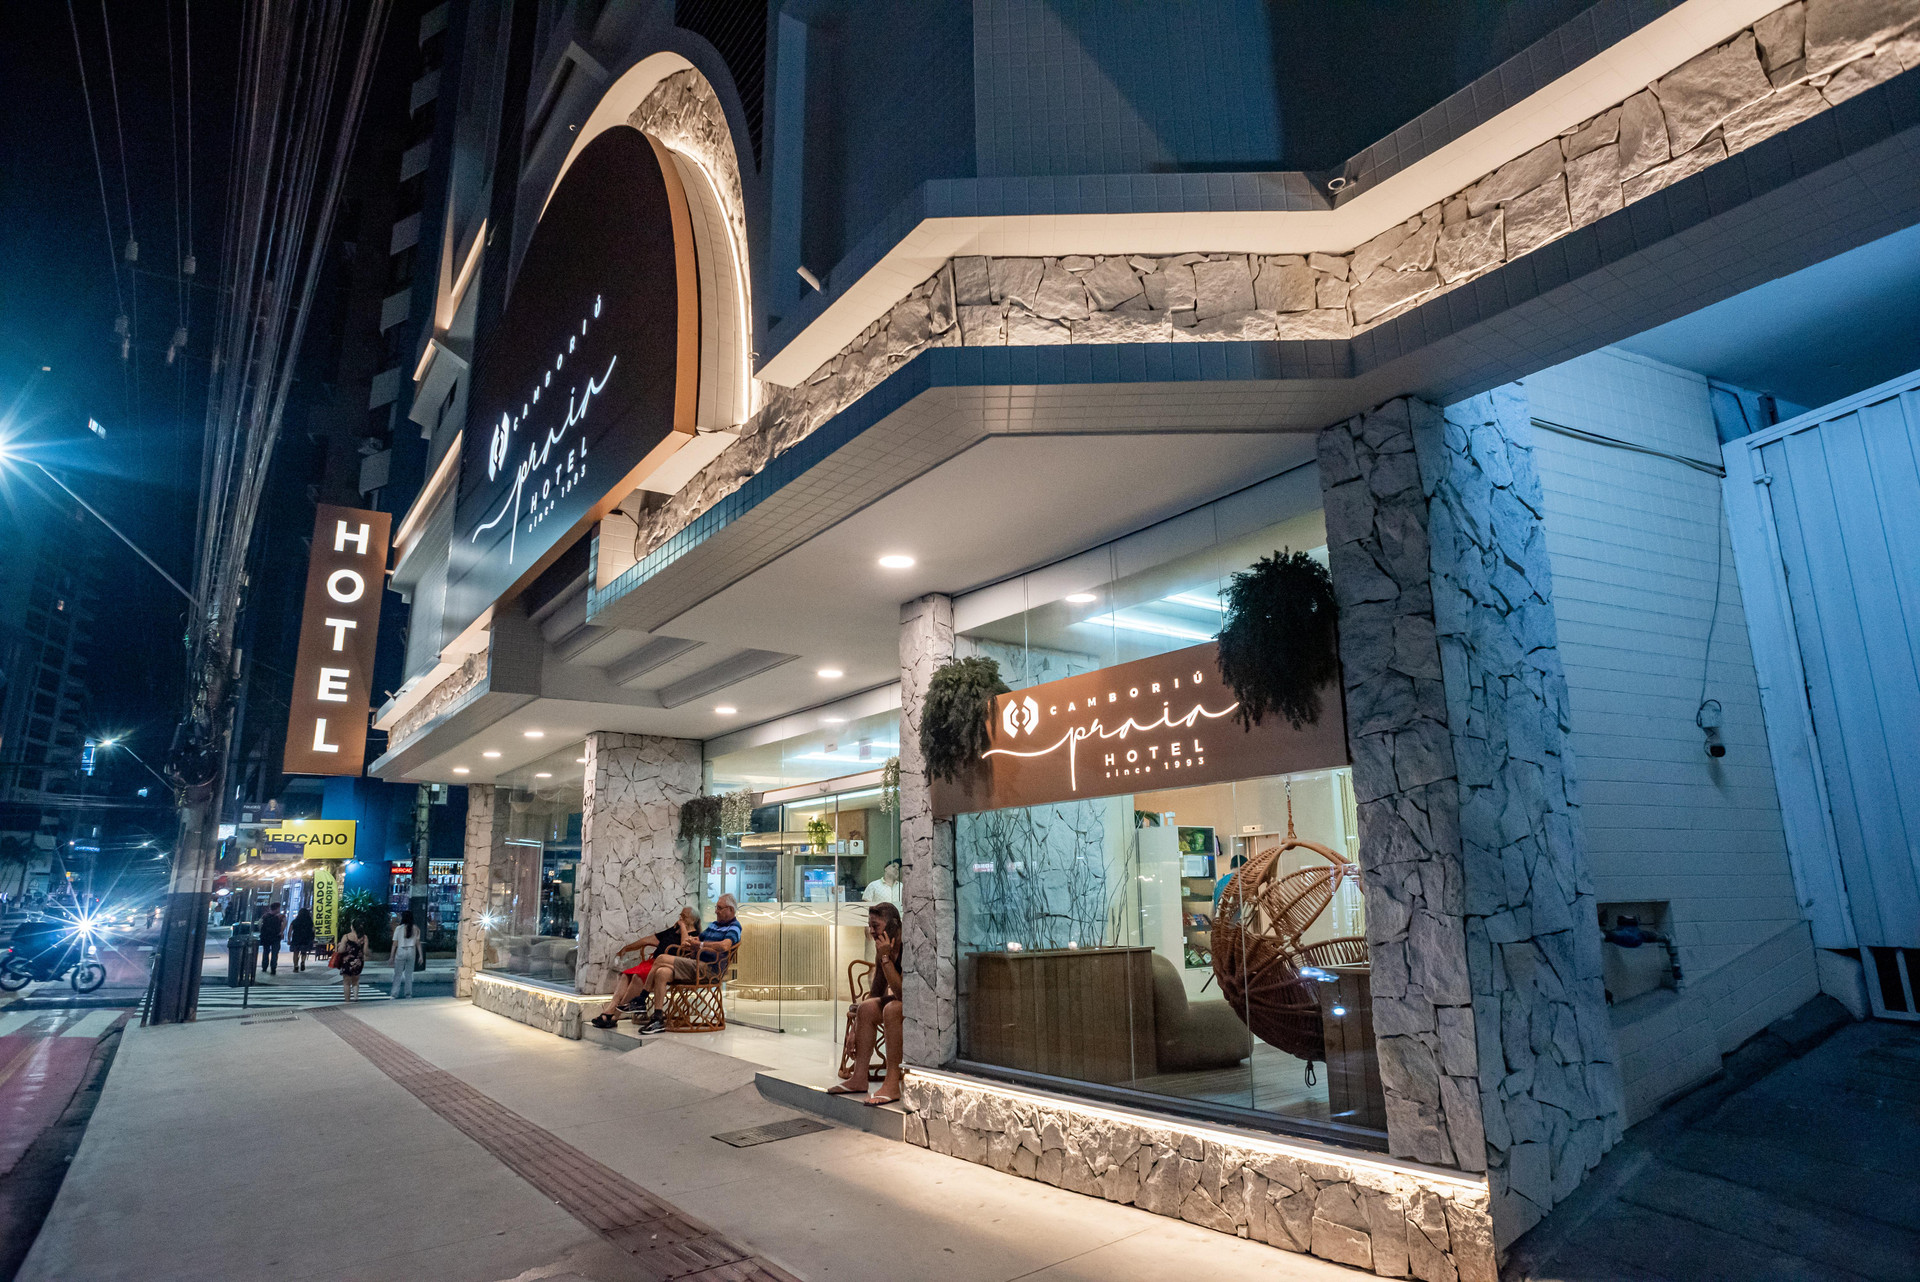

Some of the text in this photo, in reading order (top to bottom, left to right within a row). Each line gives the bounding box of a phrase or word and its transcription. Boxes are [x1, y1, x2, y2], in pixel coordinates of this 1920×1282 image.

[513, 294, 602, 431] CAMBORIÚ
[472, 355, 616, 565] praia
[530, 436, 588, 514] HOTEL
[528, 464, 587, 532] since 1993
[312, 520, 370, 752] HOTEL
[1050, 671, 1203, 715] CAMBORIÚ
[981, 702, 1240, 791] praia
[1105, 739, 1204, 766] HOTEL
[1105, 757, 1205, 778] since 1993
[266, 833, 348, 845] ERCADO
[316, 881, 325, 935] MERCADO
[325, 881, 333, 908] NORTE
